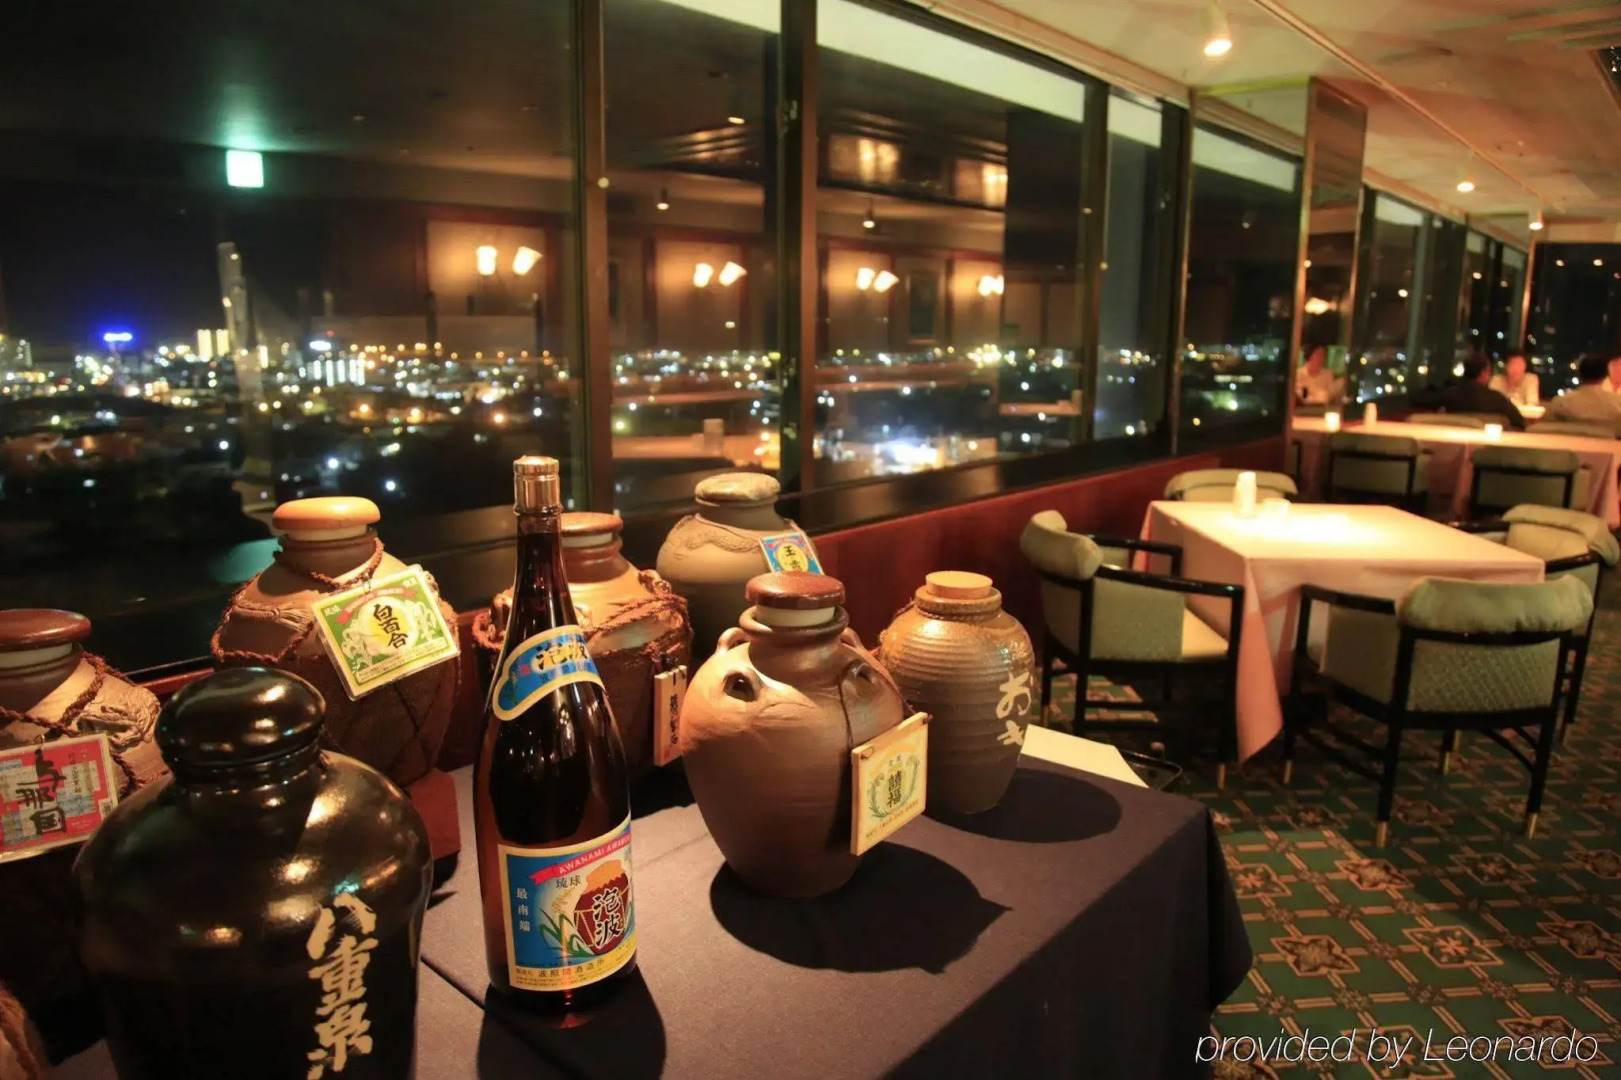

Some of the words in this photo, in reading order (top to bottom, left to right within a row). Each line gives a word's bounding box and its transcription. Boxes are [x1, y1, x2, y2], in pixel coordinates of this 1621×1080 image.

[373, 604, 409, 649] 白百合
[16, 749, 67, 835] 与那国
[559, 849, 605, 874] AWANAMI
[606, 833, 631, 853] AWAMO
[556, 875, 581, 889] 琉球
[516, 888, 531, 932] 最南端
[593, 888, 621, 949] 泡波
